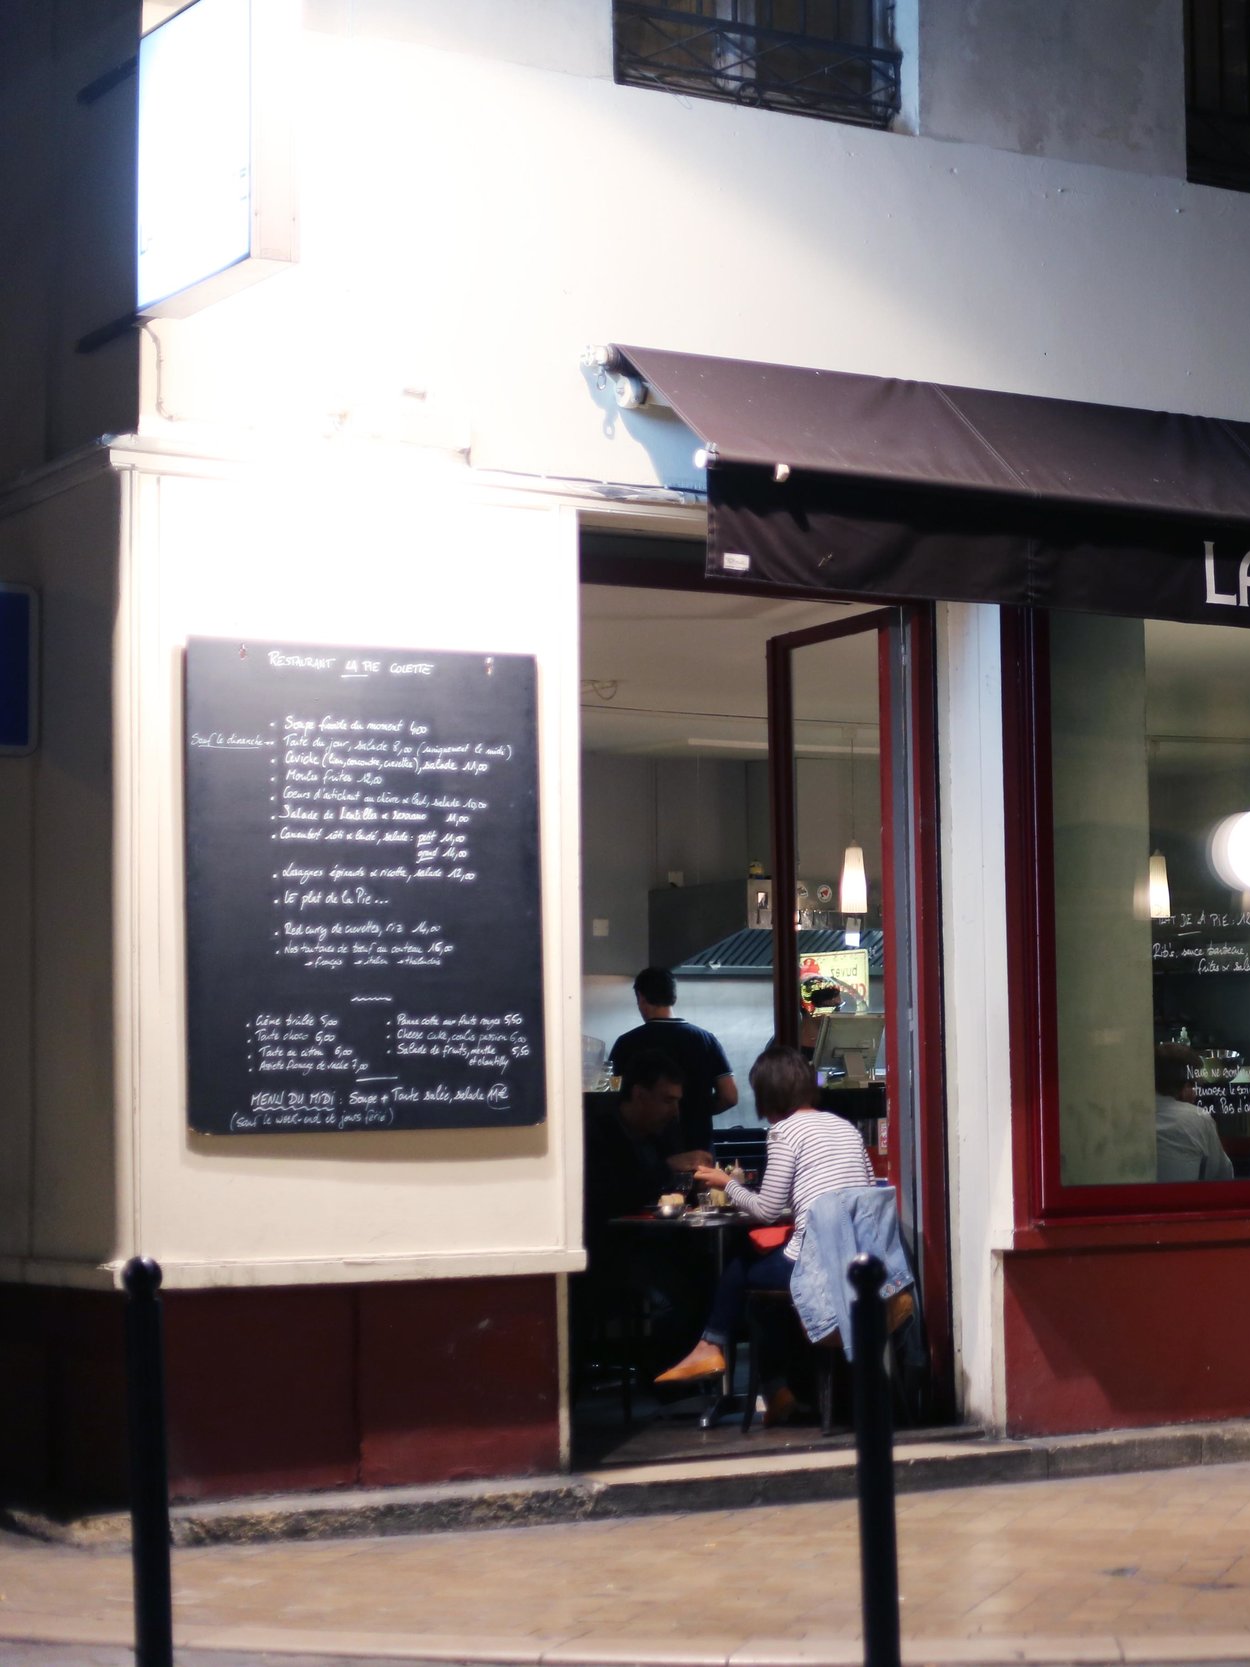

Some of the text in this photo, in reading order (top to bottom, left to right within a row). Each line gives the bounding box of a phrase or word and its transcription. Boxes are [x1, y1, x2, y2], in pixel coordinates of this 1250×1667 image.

[268, 650, 434, 675] RESTAURANT LA PIE COLETTE
[284, 715, 314, 736] Soupe
[318, 715, 347, 731] froide
[351, 721, 363, 731] du
[366, 720, 402, 731] moment
[191, 733, 263, 747] Sauf le dimanche
[283, 733, 308, 747] Tarte
[313, 735, 324, 747] du
[354, 738, 388, 751] salade
[392, 739, 413, 756] 8,00
[475, 743, 484, 754] le
[285, 750, 319, 766] Ceviche
[422, 758, 458, 771] salade
[462, 761, 488, 776] 11,00
[286, 770, 318, 781] Moules
[323, 769, 352, 784] frites
[431, 796, 461, 807] salade
[462, 798, 487, 810] 10,00
[279, 804, 319, 820] Salade
[324, 810, 335, 820] de
[446, 813, 470, 827] 11,00
[280, 827, 323, 840] Camembert
[440, 832, 466, 846] 11,00
[282, 862, 324, 885] Lasagnes
[329, 864, 365, 882] épinards
[413, 866, 442, 878] salade
[447, 867, 476, 882] 12,00
[301, 890, 322, 910] plat
[325, 892, 338, 904] de
[341, 890, 354, 904] la
[284, 922, 303, 935] Red
[305, 924, 328, 941] curry
[331, 924, 342, 934] de
[385, 924, 404, 934] riz
[337, 944, 348, 953] de
[1181, 947, 1204, 957] sauce
[1198, 958, 1220, 974] frites
[503, 1013, 523, 1026] 5,50
[255, 1028, 336, 1046] Tarte choco 6,00
[396, 1029, 424, 1040] Cheese
[509, 1030, 528, 1044] 6,00
[258, 1045, 284, 1057] Tarte
[300, 1046, 325, 1057] citron
[334, 1045, 353, 1059] 6,00
[396, 1042, 428, 1055] Salade
[429, 1045, 441, 1055] de
[511, 1044, 531, 1058] 5,50
[316, 1060, 328, 1070] de
[251, 1090, 285, 1106] MENU
[287, 1092, 305, 1105] DU
[349, 1091, 378, 1111] Soupe
[380, 1095, 389, 1104] +
[391, 1086, 420, 1101] Tarte
[453, 1086, 486, 1101] salade
[262, 1113, 272, 1125] le
[324, 1114, 337, 1124] et
